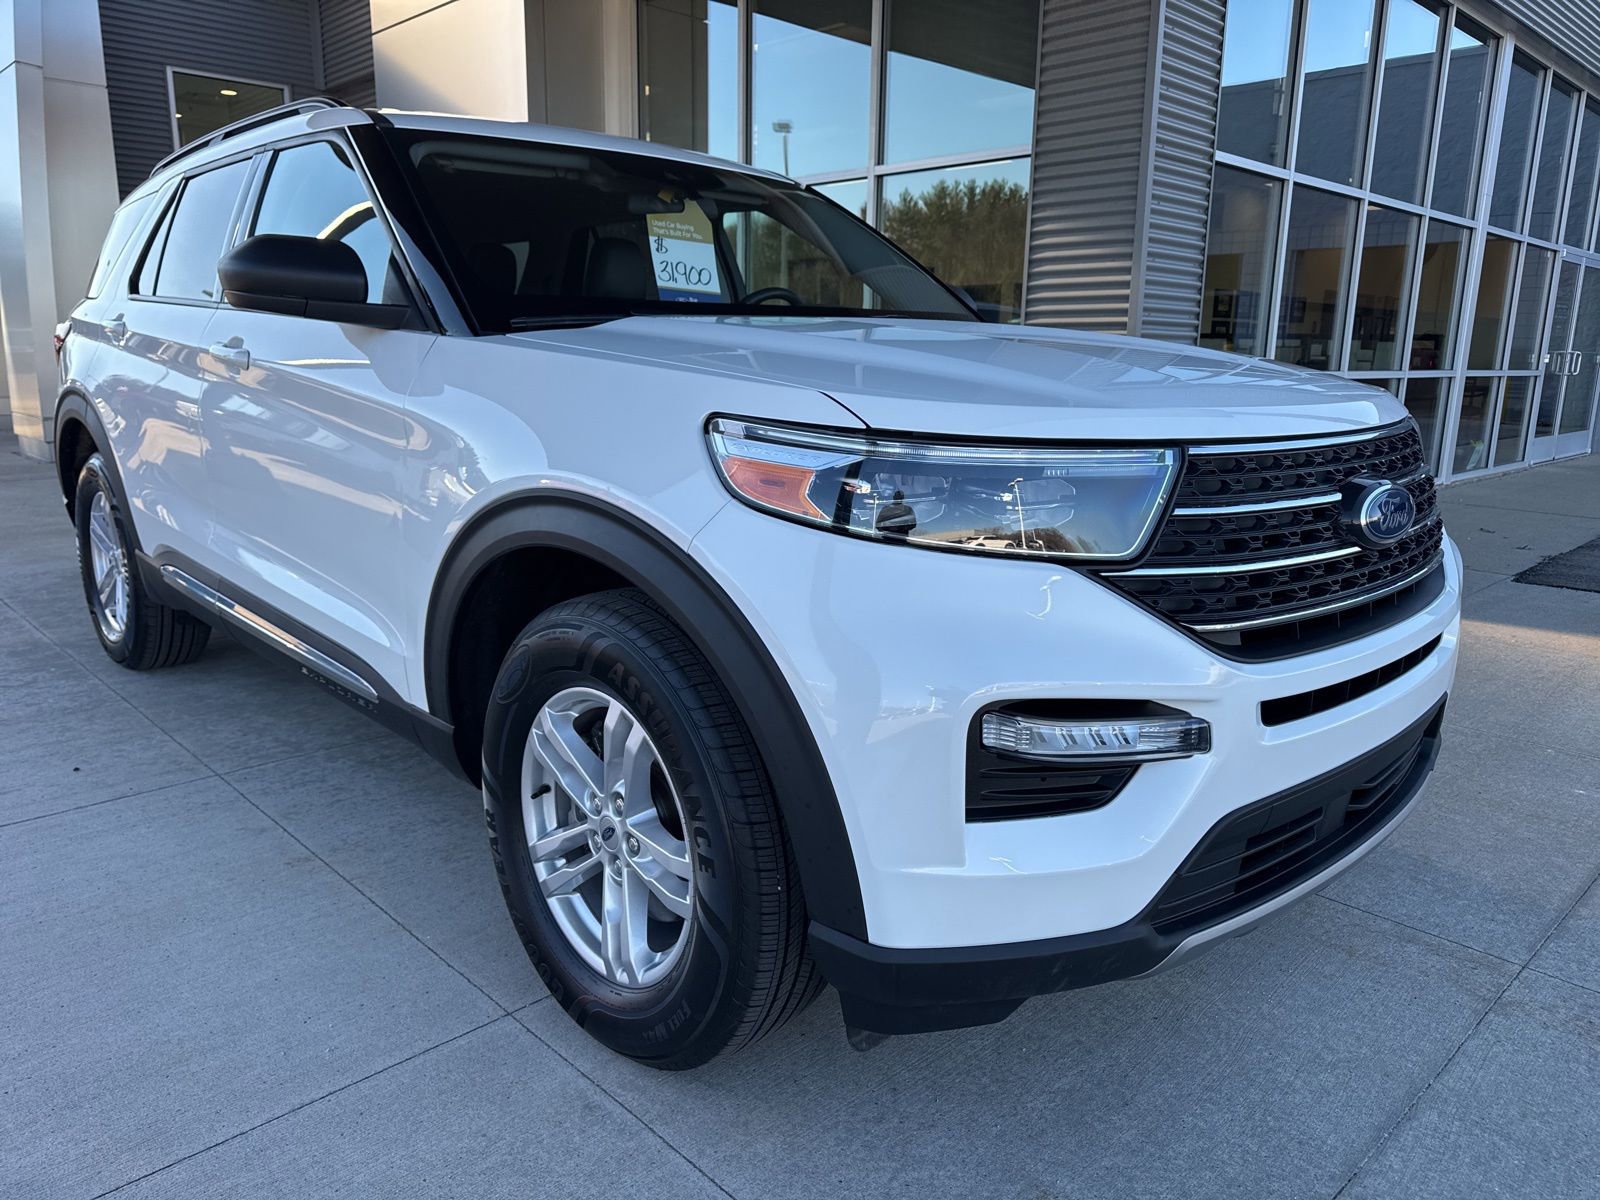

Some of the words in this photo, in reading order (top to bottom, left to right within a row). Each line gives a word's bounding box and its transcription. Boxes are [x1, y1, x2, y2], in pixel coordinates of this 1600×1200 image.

[652, 220, 665, 228] Used
[676, 223, 694, 231] Buying
[682, 230, 691, 238] For
[1380, 497, 1410, 530] Ford
[607, 661, 717, 880] ASSURANCE
